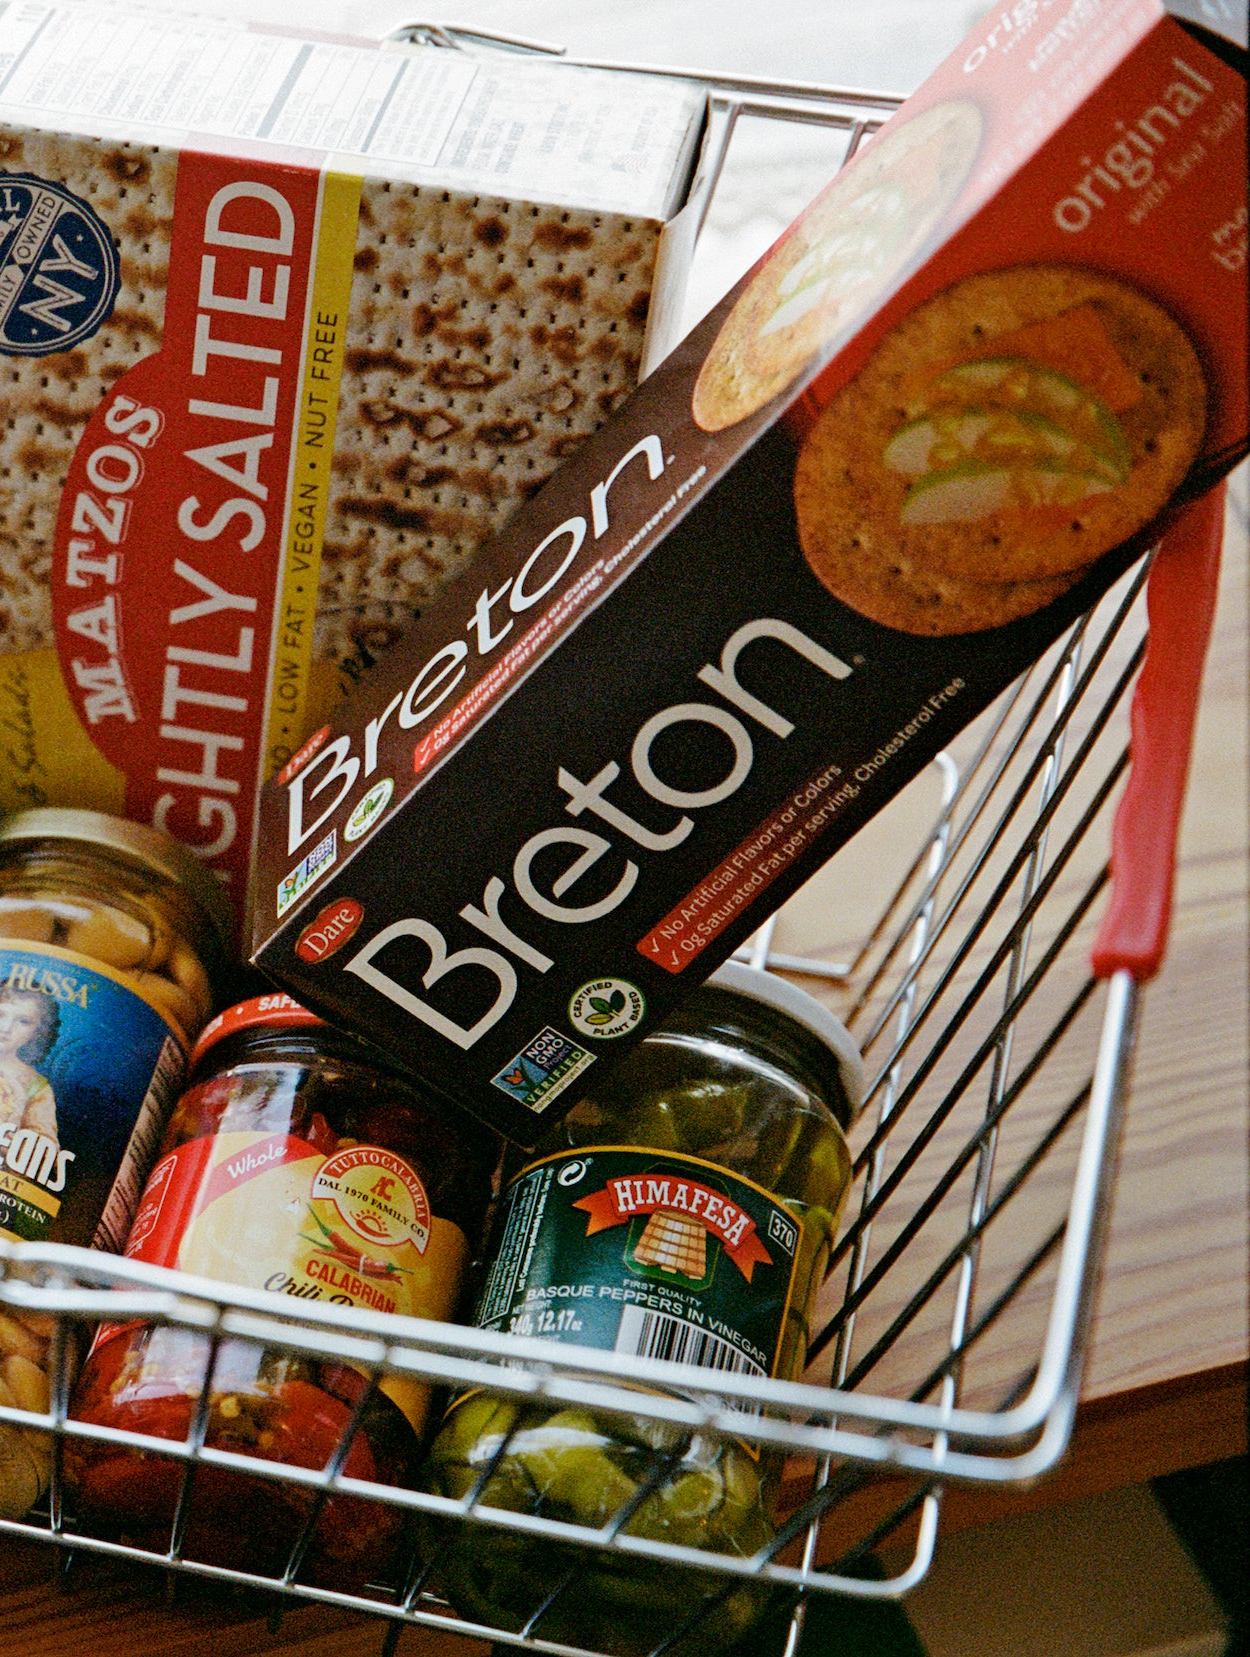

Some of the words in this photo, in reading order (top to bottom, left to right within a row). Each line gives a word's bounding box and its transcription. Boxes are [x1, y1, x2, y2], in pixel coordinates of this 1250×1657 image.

[1054, 57, 1214, 234] original
[16, 196, 56, 260] OWNED
[18, 233, 99, 333] NY
[177, 180, 298, 553] SALTED
[313, 310, 339, 383] FREE
[306, 389, 330, 450] NUT
[291, 482, 319, 573] VEGAN
[66, 395, 165, 725] MATZOS
[283, 604, 303, 647] FAT
[450, 667, 510, 733] Saturated
[510, 647, 531, 670] Fat
[531, 626, 552, 653] per
[603, 494, 678, 574] Cholesterol
[676, 464, 707, 500] Free
[287, 434, 665, 857] Breton
[433, 720, 452, 739] No
[453, 659, 503, 717] Artificial
[502, 618, 548, 670] Flavors
[548, 601, 563, 618] or
[563, 558, 605, 603] Colors
[155, 559, 259, 858] GHTLY
[278, 658, 303, 715] LOW
[343, 616, 854, 1051] Breton
[680, 929, 707, 954] 0g
[699, 871, 764, 938] Saturated
[760, 850, 786, 876] Fat
[782, 829, 807, 859] per
[804, 782, 862, 834] serving,
[853, 704, 936, 783] Cholesterol
[933, 676, 966, 711] Free
[658, 918, 683, 941] No
[681, 864, 738, 922] Artificial
[735, 821, 785, 871] Flavors
[780, 808, 797, 825] or
[793, 764, 843, 810] Colors
[303, 907, 358, 960] Dare
[2, 962, 89, 1010] RUSSA
[573, 981, 613, 1018] CERTIFIED
[592, 1021, 630, 1037] PLANT
[627, 991, 642, 1021] BASED
[525, 1032, 556, 1060] NON
[526, 1050, 583, 1103] VERIFIED
[535, 1038, 565, 1065] GMO
[227, 1142, 288, 1180] Whole
[329, 1151, 426, 1219] TUTTOCALABRIA
[317, 1177, 342, 1192] DAL
[344, 1186, 369, 1203] 1970
[370, 1197, 410, 1226] FAMILY
[410, 1222, 427, 1241] CO.
[612, 1178, 750, 1248] HIMAFESA
[771, 1216, 794, 1250] 370
[262, 1271, 322, 1304] Chili
[305, 1258, 397, 1315] CALABRIAN
[622, 1278, 657, 1293] FIRST
[656, 1285, 703, 1308] QUALITY
[526, 1284, 594, 1301] BASQUE
[598, 1285, 684, 1316] PEPPERS
[686, 1304, 706, 1324] IN
[707, 1315, 768, 1366] VINEGAR
